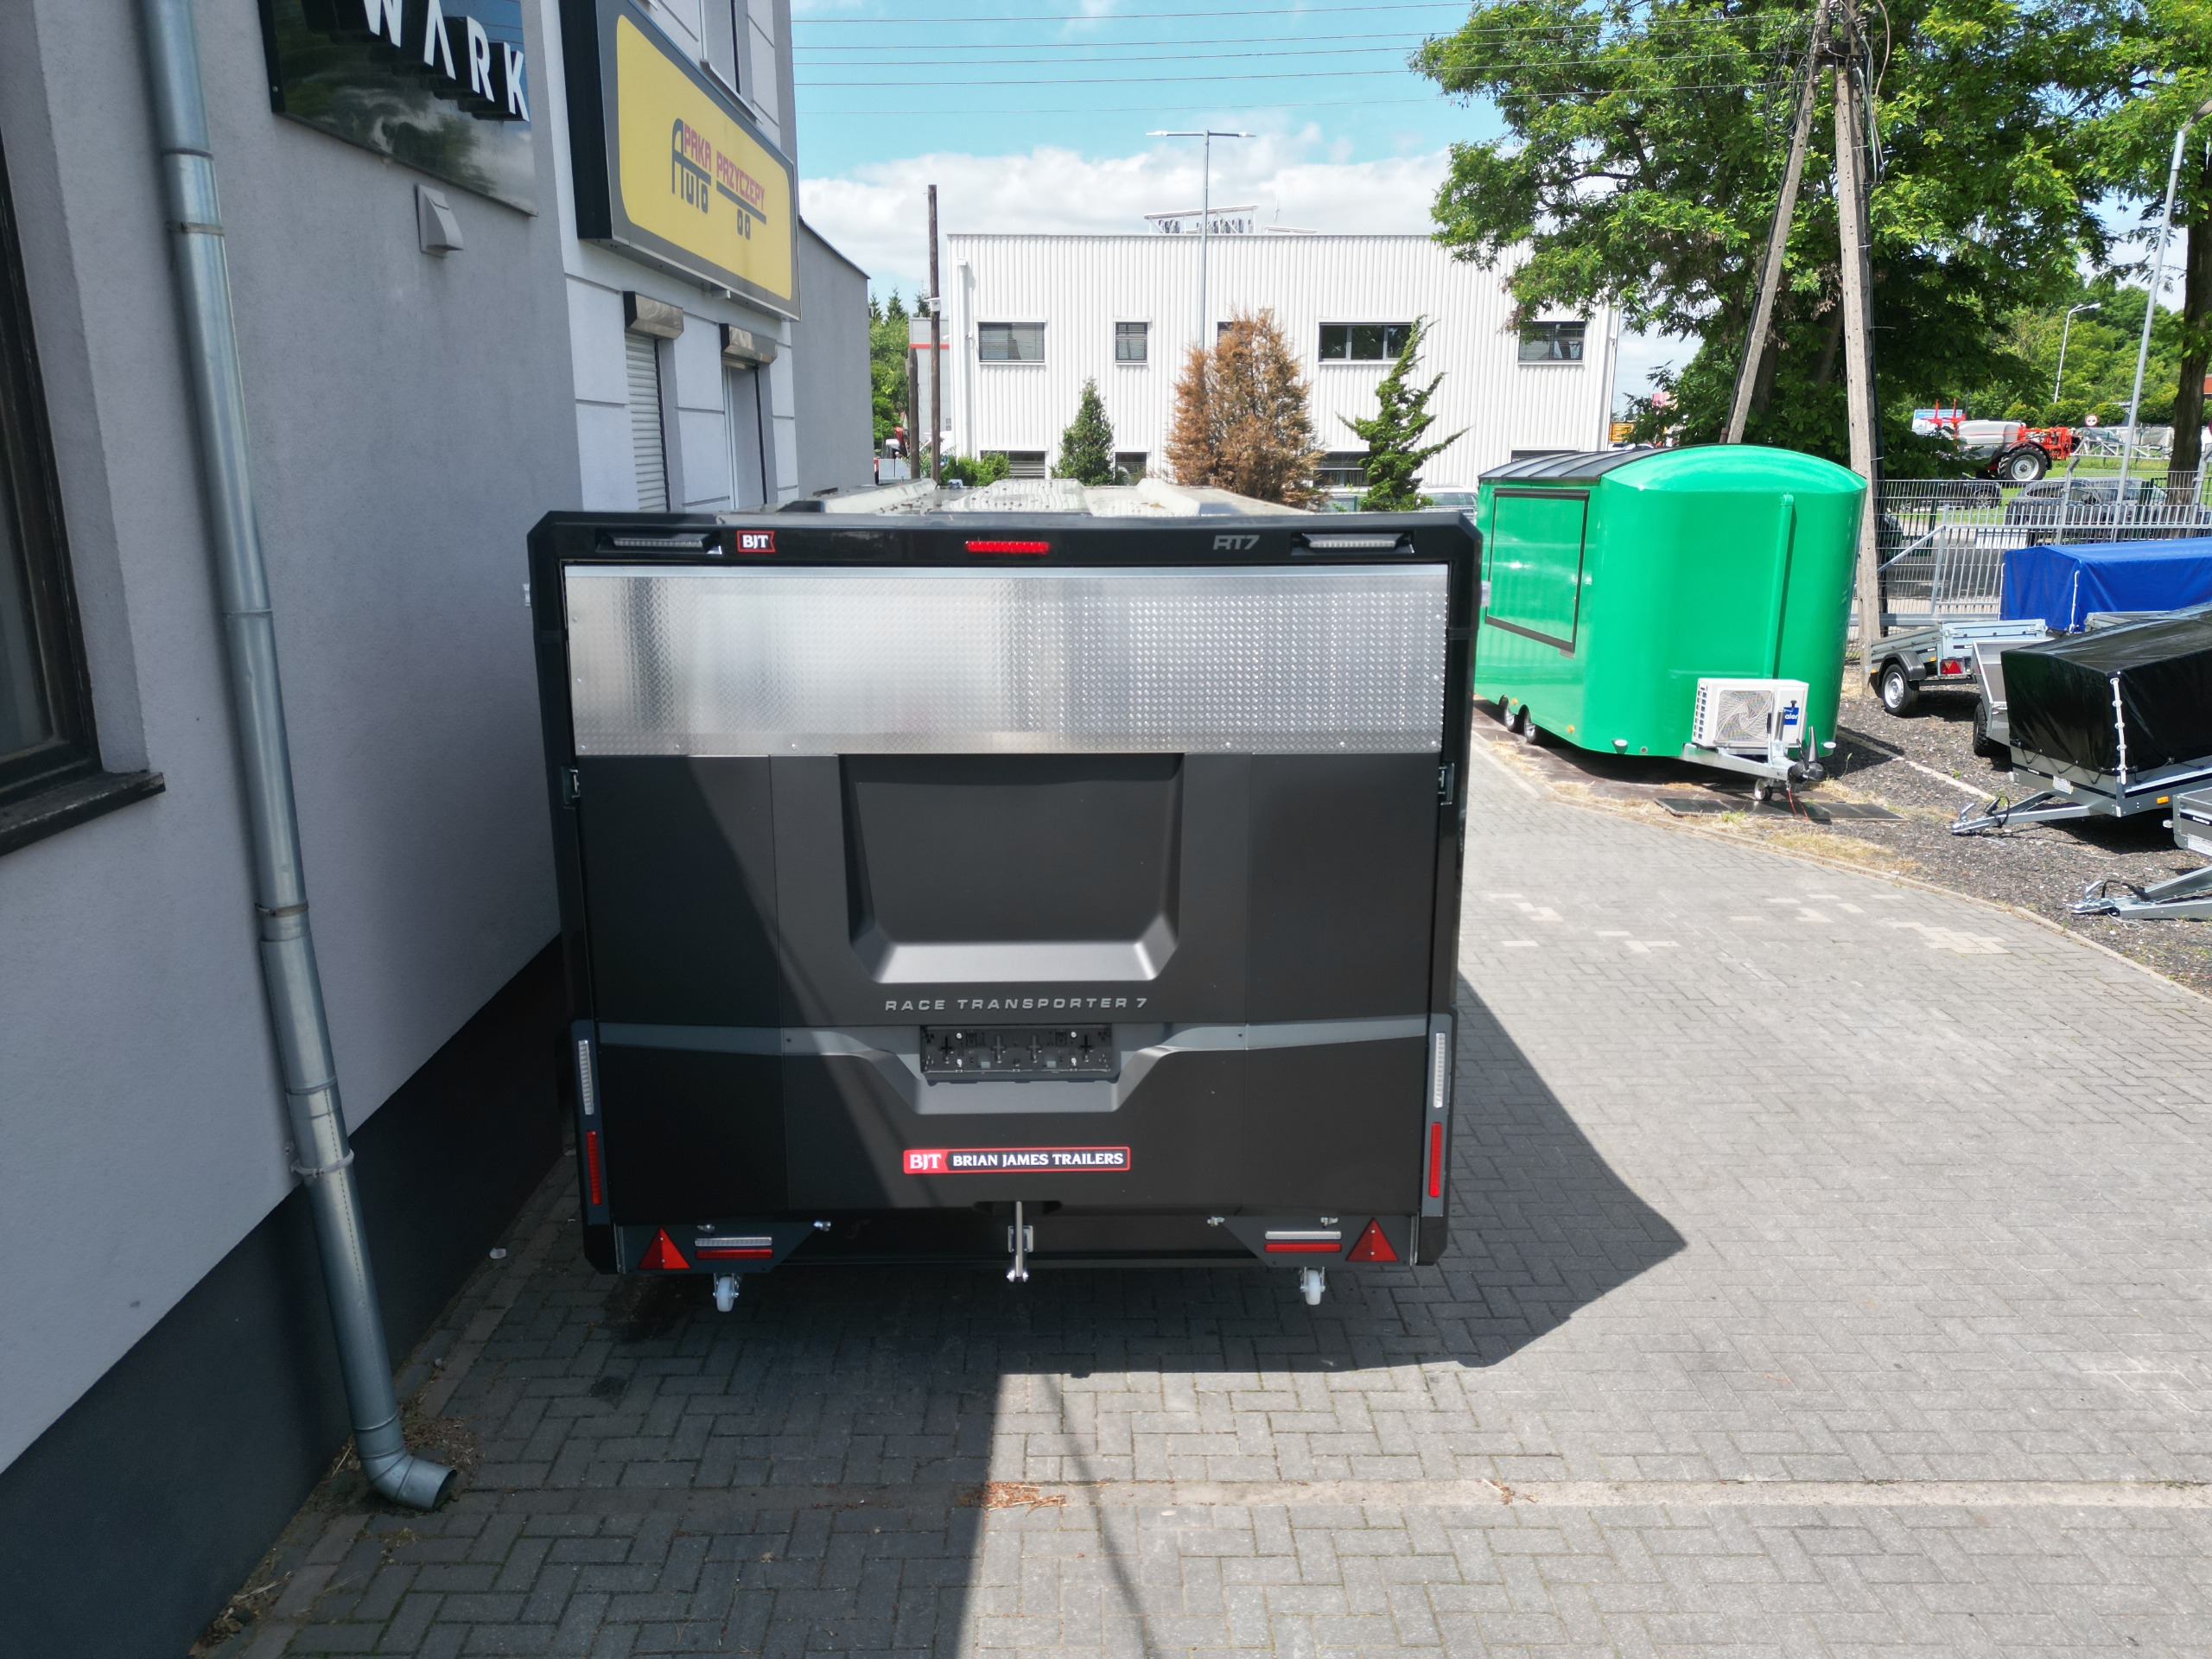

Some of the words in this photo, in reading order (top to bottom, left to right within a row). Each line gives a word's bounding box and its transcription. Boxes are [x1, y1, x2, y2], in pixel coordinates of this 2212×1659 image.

[716, 150, 765, 211] PRZYCZEPY
[742, 534, 768, 549] BJT
[1212, 535, 1260, 550] RT7
[885, 1000, 945, 1011] RACE
[957, 998, 1127, 1009] TRANSPORTER
[1136, 998, 1147, 1008] 7
[909, 1154, 941, 1170] BJT
[953, 1154, 998, 1166] BRIAN
[1002, 1154, 1049, 1167] JAMES
[1052, 1153, 1124, 1166] TRAILERS
